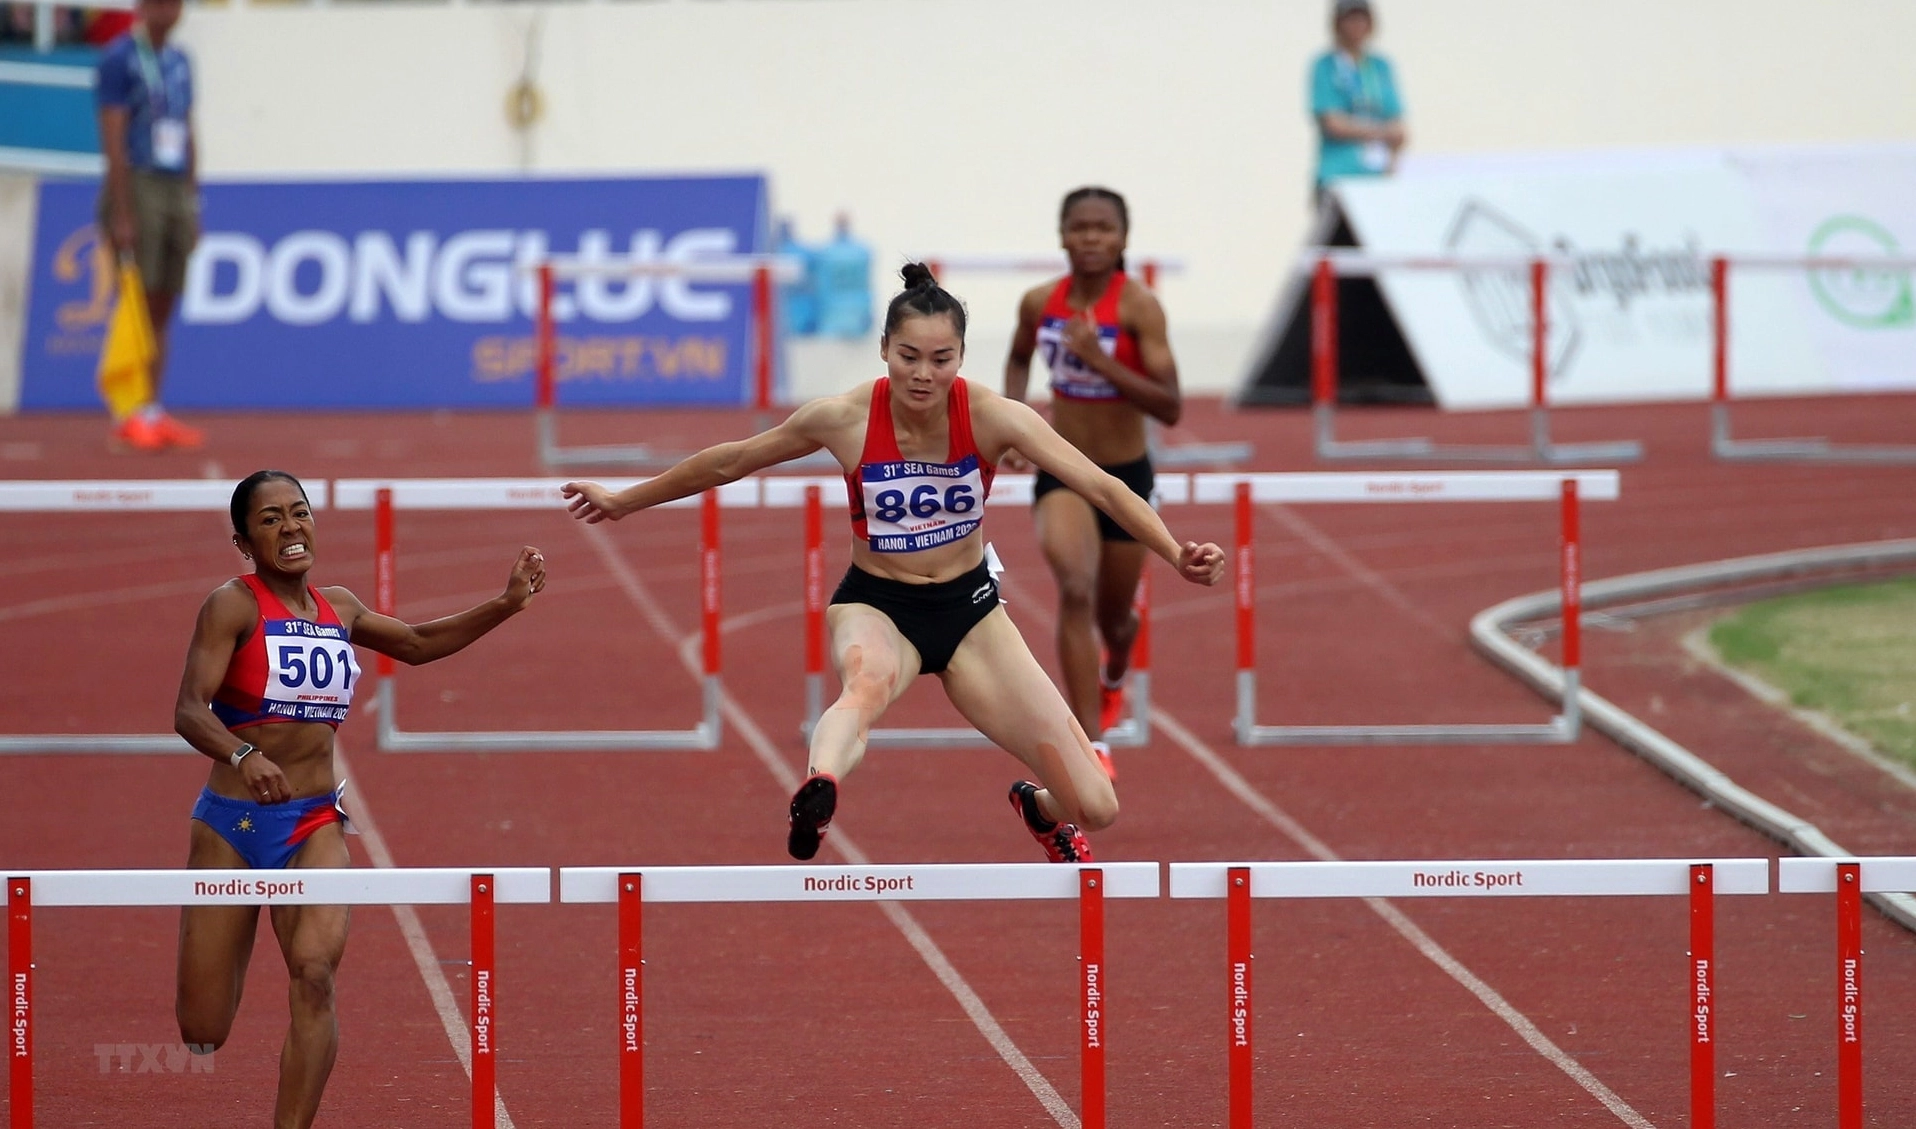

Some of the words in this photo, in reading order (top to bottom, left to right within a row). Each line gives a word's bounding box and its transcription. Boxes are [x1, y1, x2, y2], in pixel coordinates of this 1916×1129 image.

[181, 228, 738, 325] DONGLUC
[903, 462, 923, 475] SEA
[926, 465, 960, 477] Games
[875, 485, 976, 523] 866
[878, 537, 907, 551] HANOI
[915, 527, 954, 549] VIETNAM
[910, 519, 946, 532] VIETNAM
[303, 622, 316, 637] SEA
[315, 625, 341, 638] Games
[278, 645, 352, 690] 501
[268, 702, 297, 717] HANOI
[304, 705, 333, 719] VIETNAM
[297, 694, 339, 702] PHILIPPINES
[255, 879, 304, 899] Sport
[864, 875, 914, 894] Sport
[1474, 871, 1523, 890] Sport
[12, 1019, 28, 1057] Sport
[474, 1016, 490, 1054] Sport
[622, 1014, 637, 1052] Sport
[1084, 1010, 1099, 1048] Sport
[1232, 1008, 1247, 1047] Sport
[1694, 1005, 1709, 1043] Sport
[1842, 1005, 1857, 1043] Sport
